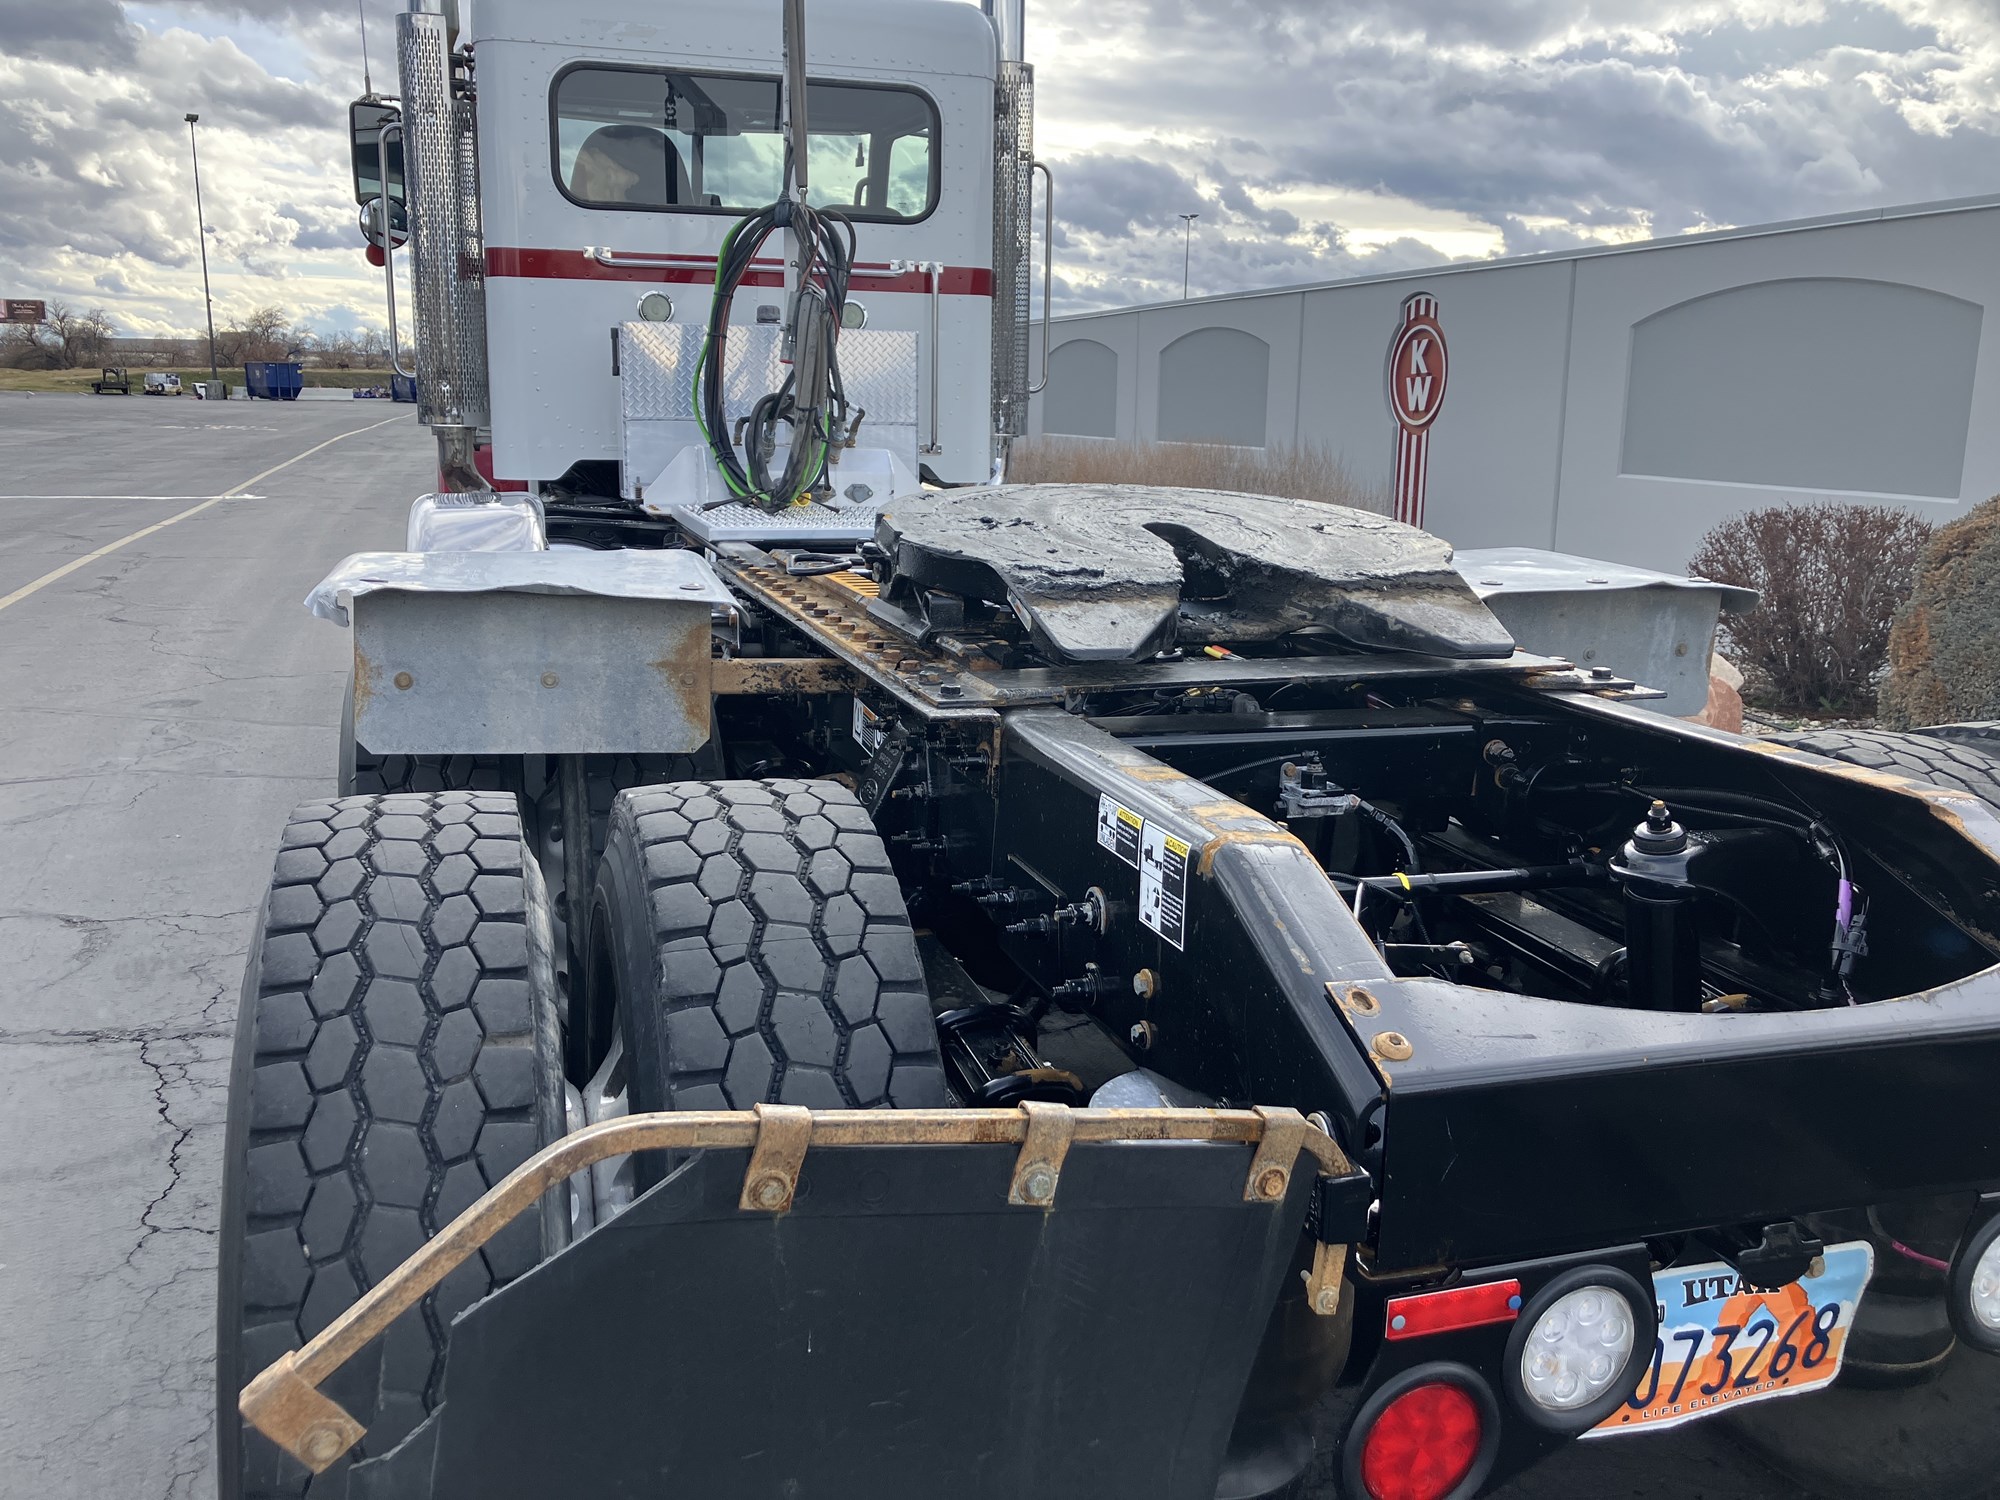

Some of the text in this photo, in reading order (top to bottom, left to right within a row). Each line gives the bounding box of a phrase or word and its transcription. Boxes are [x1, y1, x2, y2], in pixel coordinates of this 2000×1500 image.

[1118, 810, 1139, 827] ATTENTION
[1168, 839, 1188, 857] CAUTION
[1682, 1274, 1780, 1308] UTA
[1643, 1381, 1776, 1418] LIFE ELEVATED
